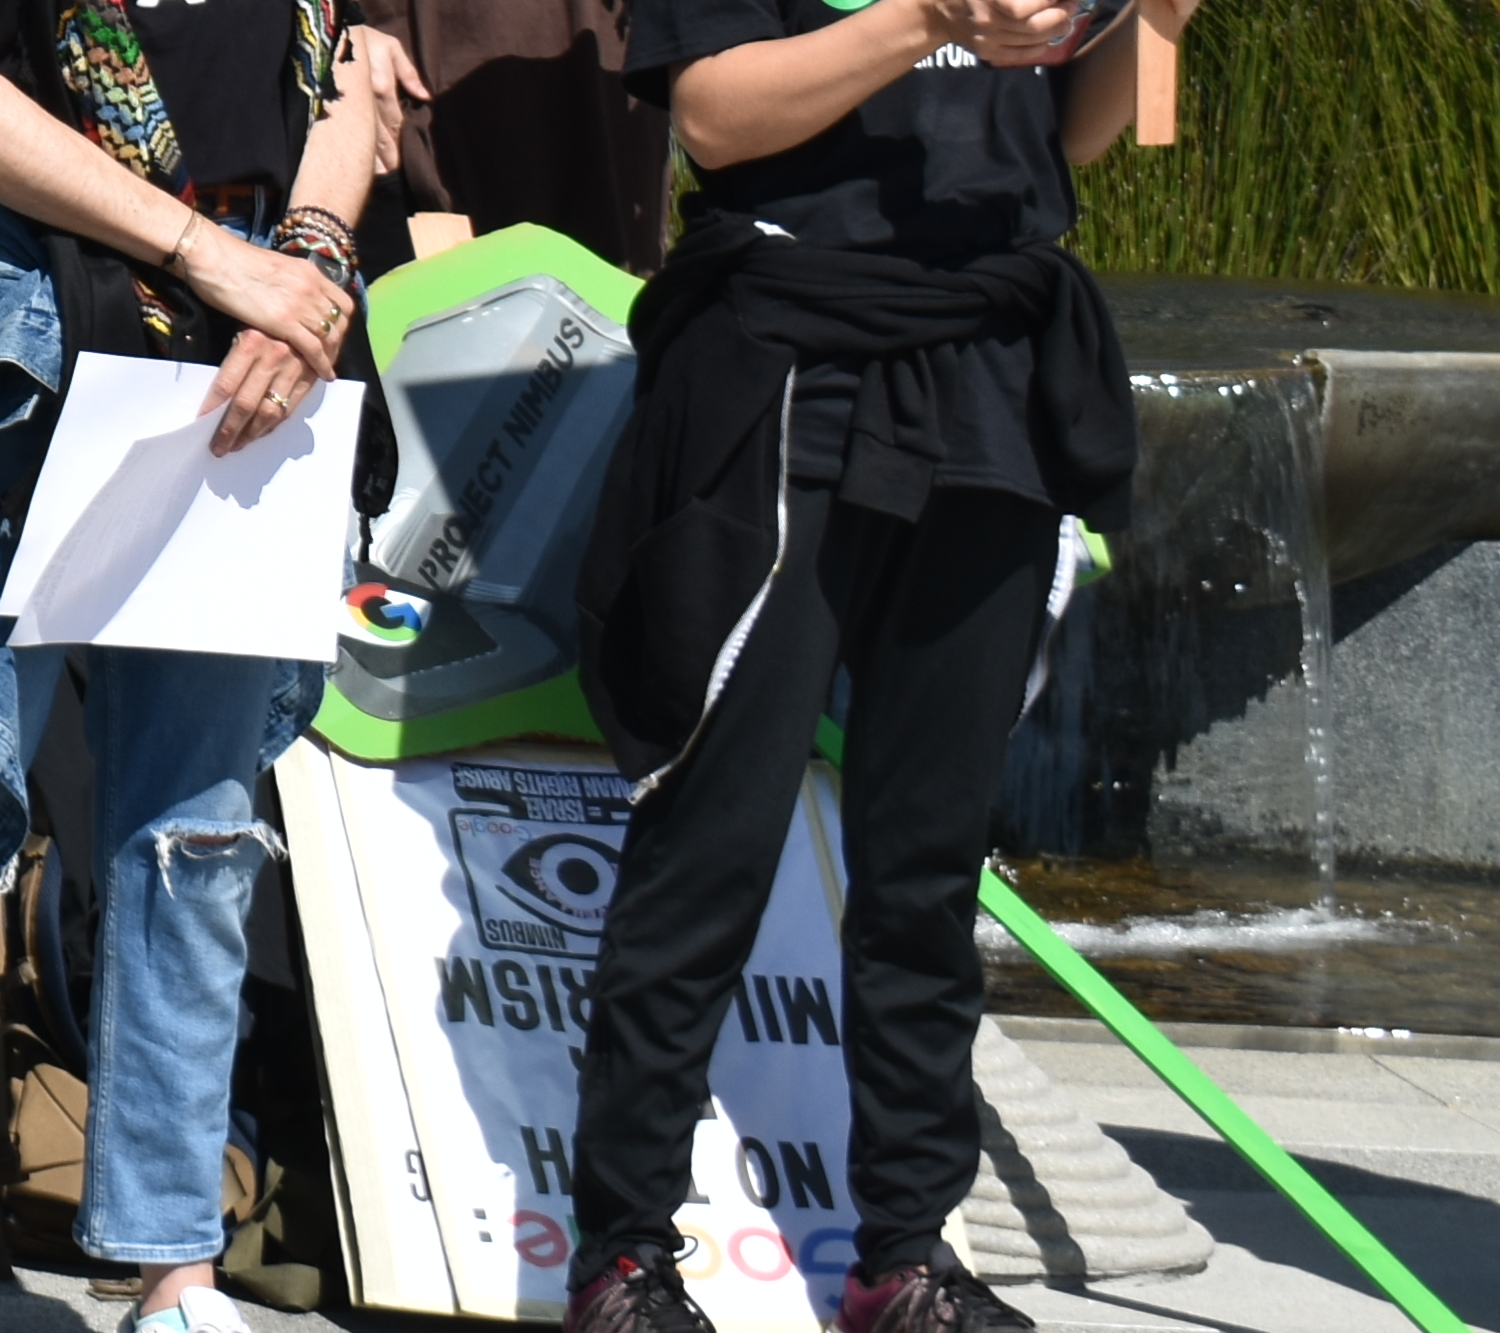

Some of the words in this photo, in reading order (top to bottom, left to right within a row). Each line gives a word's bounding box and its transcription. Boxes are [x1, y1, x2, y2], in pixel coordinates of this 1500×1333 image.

[417, 436, 512, 590] PROJECT
[502, 316, 586, 449] NIMBUS
[513, 771, 582, 797] RIGHTS
[582, 776, 633, 800] MAN
[520, 795, 586, 823] ISRAEL
[457, 817, 532, 842] Google
[484, 917, 566, 951] NIMBUS
[734, 1135, 835, 1211] NO
